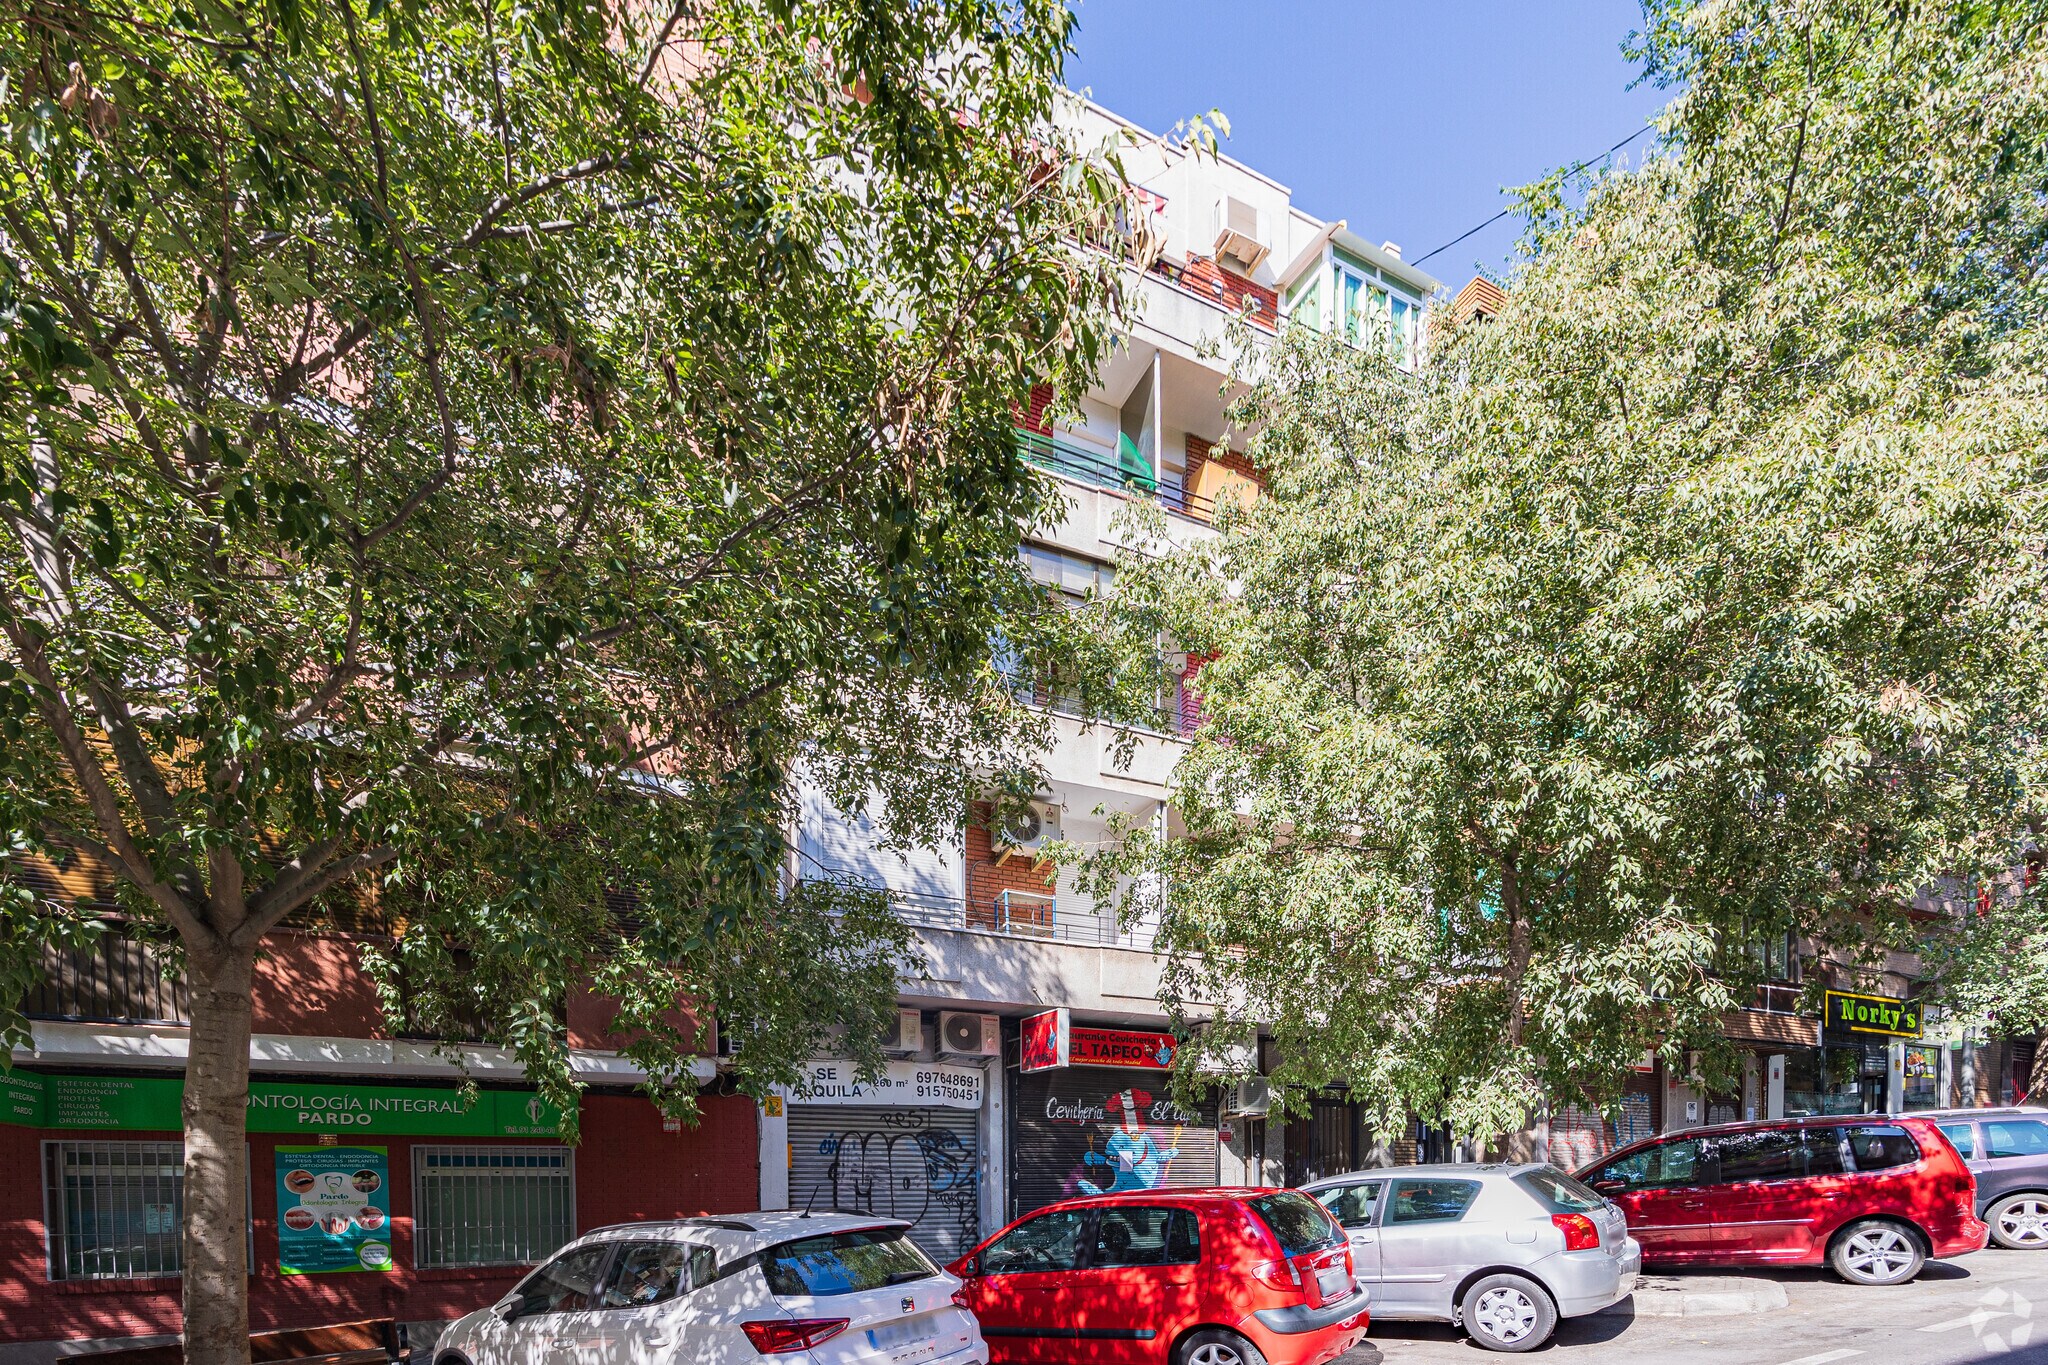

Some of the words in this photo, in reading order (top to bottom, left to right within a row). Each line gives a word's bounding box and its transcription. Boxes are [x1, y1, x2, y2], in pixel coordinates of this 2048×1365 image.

[1841, 998, 1916, 1031] Norky's
[1069, 1042, 1087, 1056] EL
[1091, 1043, 1143, 1059] TAPEO
[816, 1067, 837, 1080] SE
[916, 1071, 980, 1088] 697648691
[100, 1081, 135, 1089] DENTAL
[873, 1079, 892, 1088] 260
[8, 1090, 38, 1103] INTEGRAL
[57, 1087, 119, 1096] ENDODONCIA
[916, 1085, 980, 1101] 915750451
[13, 1105, 33, 1116] PARDO
[369, 1097, 464, 1114] INTEGRAL
[1150, 1101, 1169, 1121] El
[58, 1117, 119, 1125] ORTODONCIA
[297, 1112, 373, 1126] PARDO
